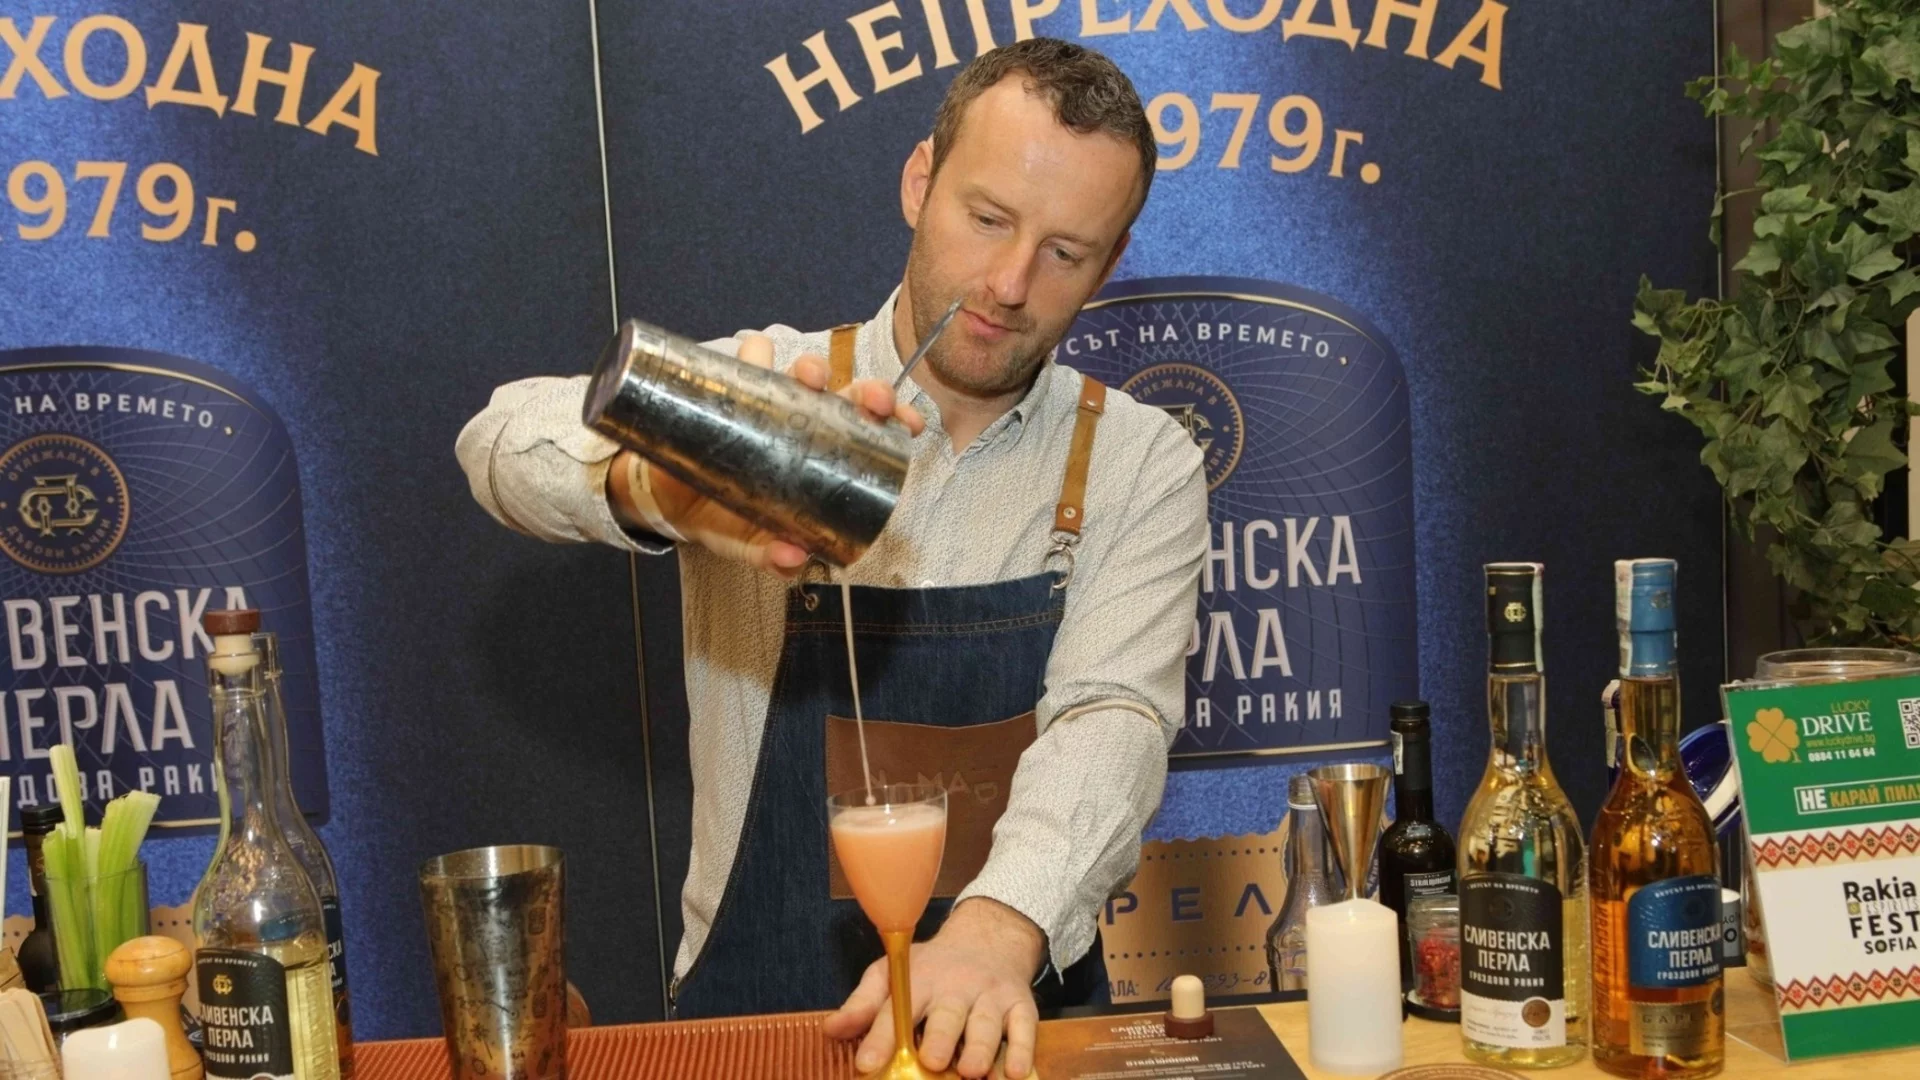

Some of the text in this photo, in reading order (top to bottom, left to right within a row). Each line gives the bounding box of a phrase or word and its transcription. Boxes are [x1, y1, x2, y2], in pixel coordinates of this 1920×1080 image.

[0, 14, 382, 156] ХОДНА
[0, 159, 257, 253] 979г.
[1139, 323, 1179, 344] НА
[1197, 322, 1330, 358] ВРЕМЕТО
[15, 393, 213, 428] НА ВРЕМЕТО
[1237, 688, 1342, 726] РАКИЯ
[1830, 699, 1869, 713] LUCKY
[1801, 712, 1873, 736] DRIVE
[1834, 750, 1846, 760] 11
[1800, 788, 1827, 810] НЕ
[1830, 784, 1880, 807] КАРАЙ
[1843, 876, 1916, 903] Rakia
[1463, 923, 1551, 951] СЛИВЕНСКА
[1849, 910, 1920, 939] FEST
[1669, 946, 1713, 969] ПЕРЛА
[1864, 936, 1917, 955] SOFIA
[1478, 950, 1531, 973] ПЕРЛА
[208, 1027, 254, 1049] ПЕРЛА
